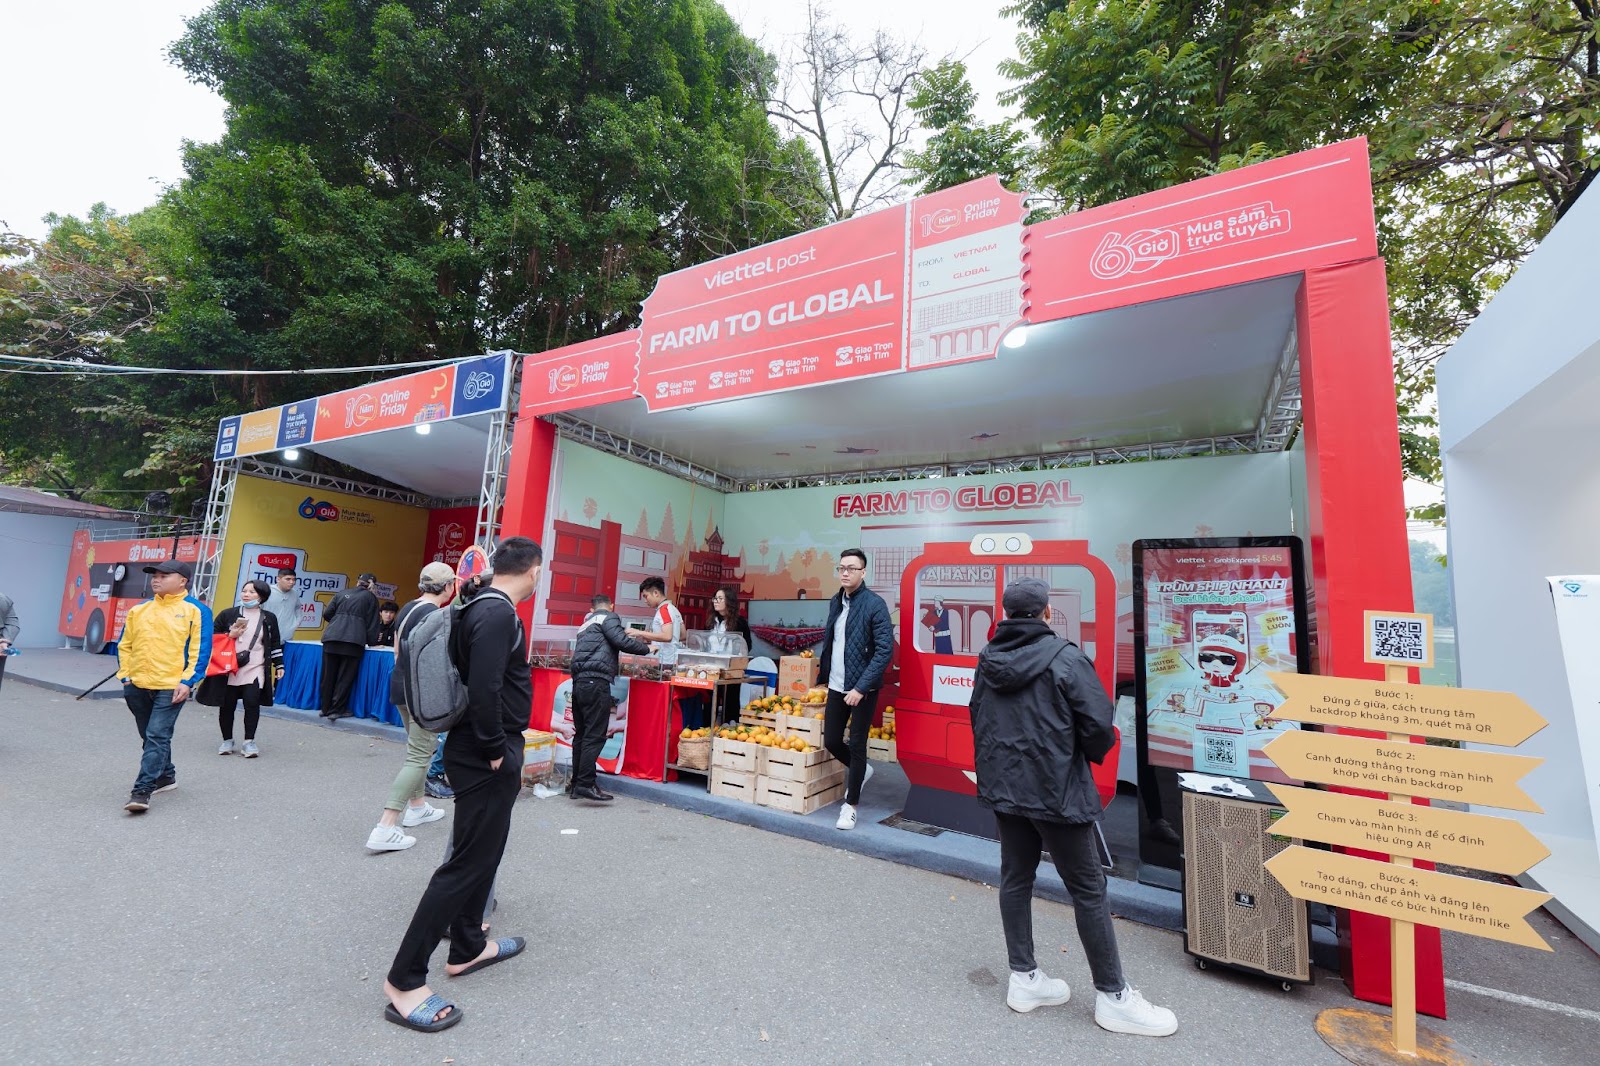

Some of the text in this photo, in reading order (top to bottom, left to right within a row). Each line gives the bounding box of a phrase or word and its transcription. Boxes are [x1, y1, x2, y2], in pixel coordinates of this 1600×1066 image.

[964, 198, 1000, 214] Online
[965, 207, 999, 223] Friday
[1187, 205, 1265, 237] Mua sắm
[1187, 214, 1282, 248] trực tuyến
[953, 243, 998, 260] VIETNAM
[1138, 239, 1169, 256] Giờ
[704, 246, 817, 290] viettel post
[953, 266, 990, 280] GLOBAL
[649, 279, 894, 354] FARM TO GLOBAL
[855, 342, 894, 355] Giao Trọn
[785, 356, 819, 368] Giao Trọn
[855, 351, 890, 363] Trái Tim
[582, 361, 609, 374] Online
[802, 364, 816, 373] Tim
[582, 371, 608, 384] Friday
[380, 389, 410, 404] Online
[380, 402, 408, 417] Friday
[833, 479, 1084, 518] FARM TO GLOBAL
[142, 546, 165, 559] Tours
[315, 576, 340, 590] mại
[1156, 579, 1286, 592] TRÙM SHIP NHANH
[1265, 615, 1289, 624] SHIP
[1375, 688, 1413, 700] Bước 1:
[1323, 695, 1476, 719] Đứng ở giữa, cách trung tâm
[1310, 704, 1492, 733] backdrop khoảng 3m, quét mã QR
[1376, 748, 1415, 760] Bước 2:
[1305, 752, 1331, 762] Canh
[1334, 756, 1368, 769] đường
[1406, 766, 1436, 778] trong
[1440, 770, 1464, 780] màn
[1333, 767, 1359, 779] khớp
[1381, 774, 1407, 784] chân
[1410, 777, 1463, 793] backdrop
[1378, 808, 1417, 822] Bước 3:
[1317, 812, 1346, 823] Chạm
[1349, 818, 1368, 827] vào
[1371, 822, 1394, 831] màn
[1425, 830, 1439, 838] để
[1442, 833, 1455, 842] cố
[1459, 835, 1485, 846] định
[1366, 832, 1432, 850] hiệu ứng AR
[1379, 872, 1419, 887] Bước 4:
[1317, 870, 1490, 912] Tạo dáng, chụp ảnh và đăng lên
[1300, 880, 1327, 893] trang
[1330, 887, 1342, 895] cá
[1345, 890, 1371, 901] nhân
[1374, 895, 1388, 904] để
[1391, 899, 1404, 908] có
[1407, 902, 1427, 912] bức
[1460, 912, 1486, 925] trăm
[1490, 917, 1511, 930] like
